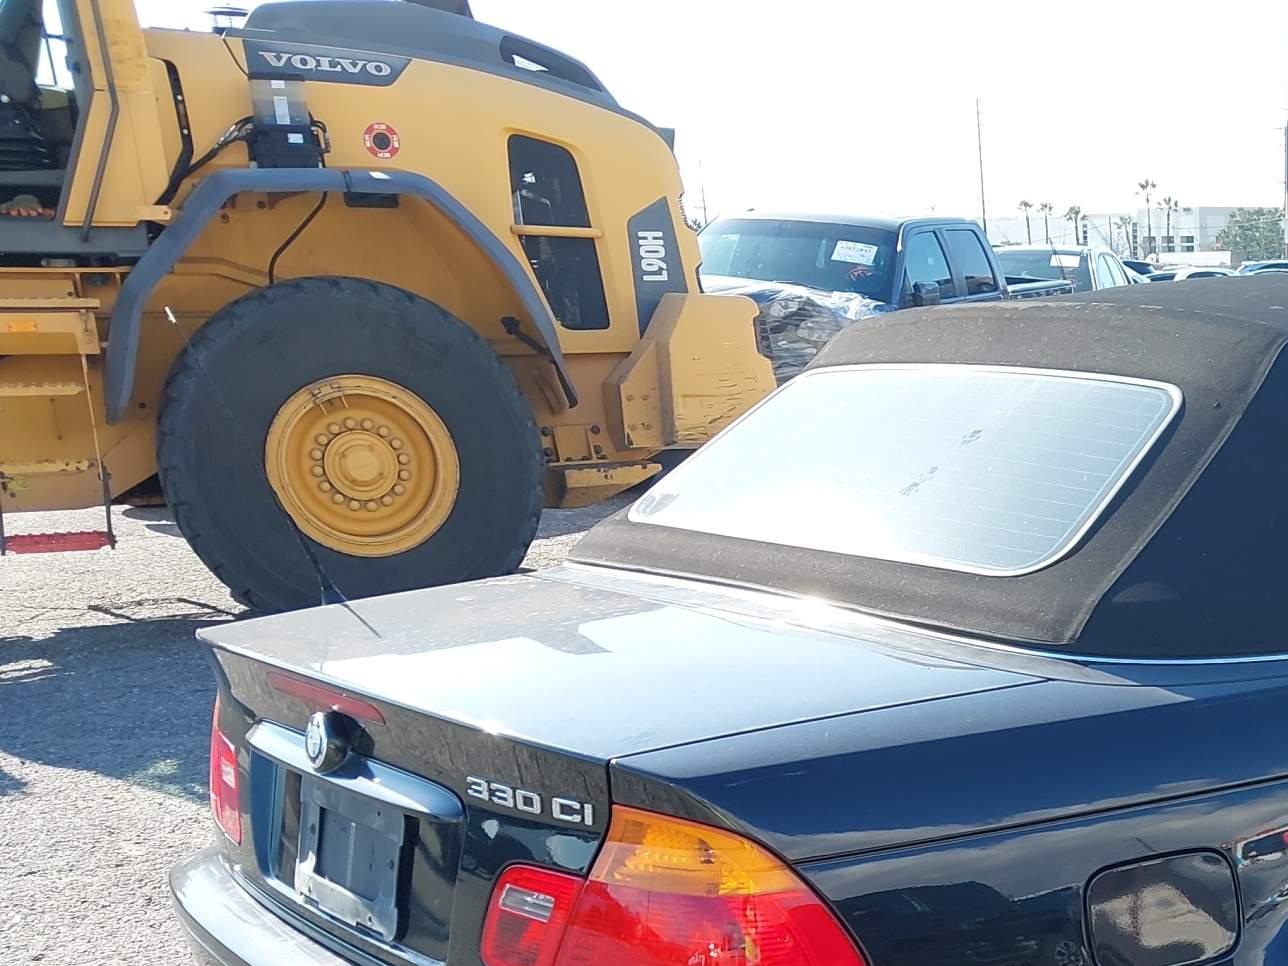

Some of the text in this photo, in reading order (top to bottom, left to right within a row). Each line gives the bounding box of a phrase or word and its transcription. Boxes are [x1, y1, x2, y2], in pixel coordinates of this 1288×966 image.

[258, 51, 392, 76] VOLVO
[637, 231, 669, 281] L90H
[466, 776, 593, 826] 330 CI
